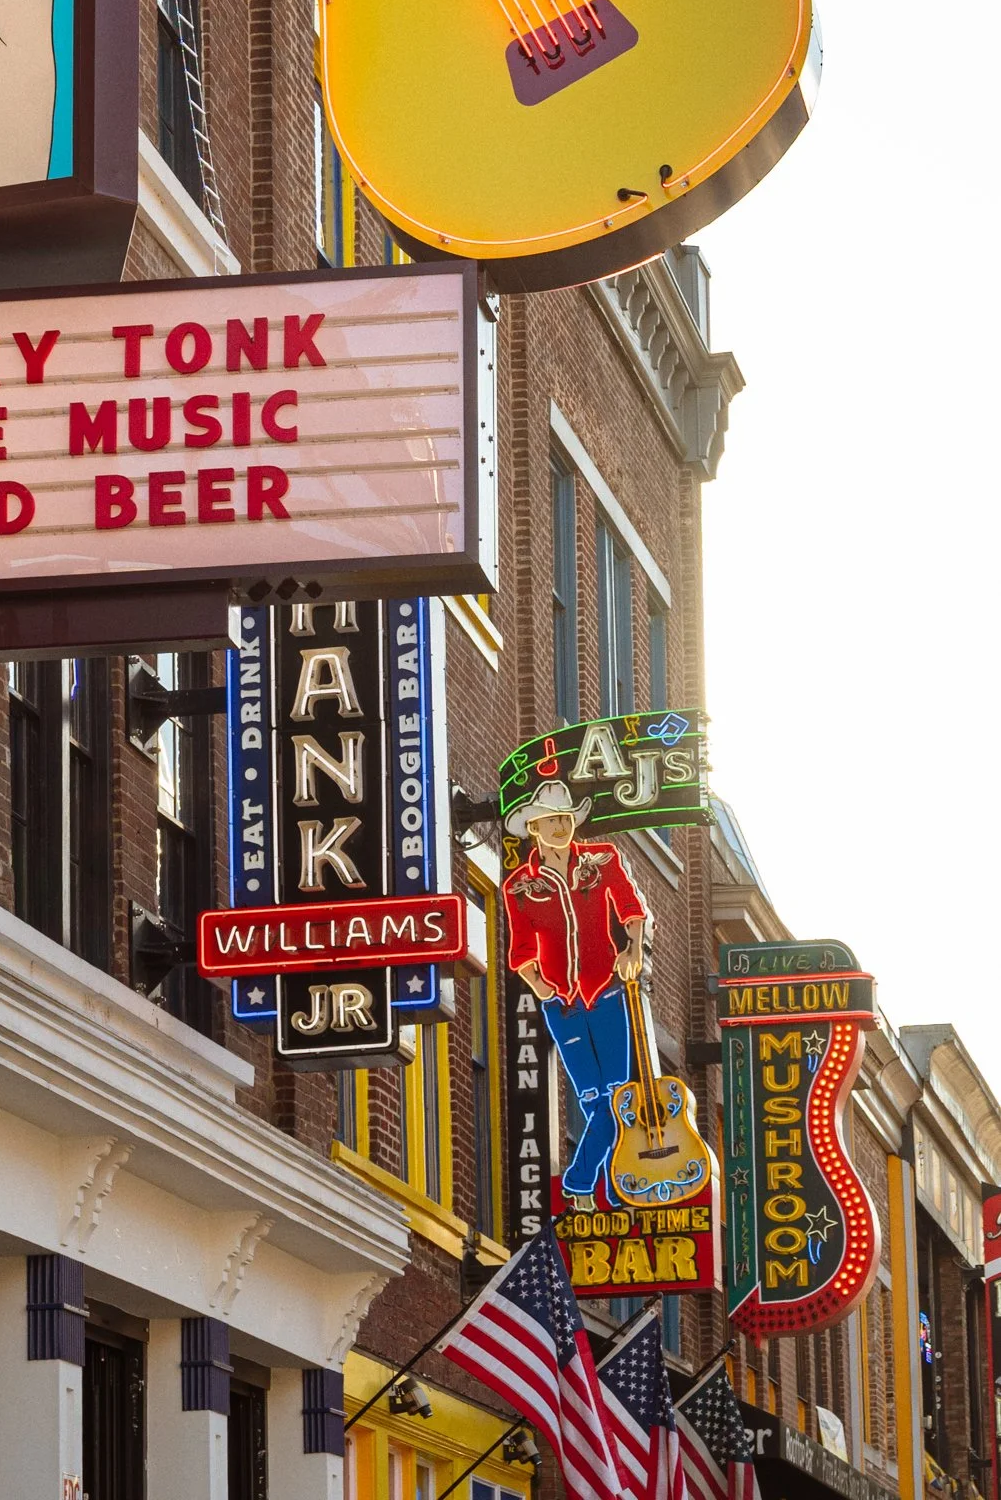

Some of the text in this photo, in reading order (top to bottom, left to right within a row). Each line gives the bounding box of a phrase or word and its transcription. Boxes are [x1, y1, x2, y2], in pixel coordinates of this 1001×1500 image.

[112, 313, 327, 378] TONK
[68, 389, 299, 455] MUSIC
[94, 465, 291, 530] BEER
[240, 636, 265, 870] EAT DRINK
[396, 623, 423, 858] BOOGIE BAR
[215, 911, 447, 955] WILLIAMS
[757, 954, 811, 974] LIVE
[290, 982, 378, 1033] JR
[729, 982, 849, 1016] MELLOW
[516, 993, 543, 1248] ALAN JACKS
[759, 1030, 809, 1289] MUSHROOM
[555, 1207, 710, 1239] GOOD TIME
[569, 1236, 698, 1286] BAR
